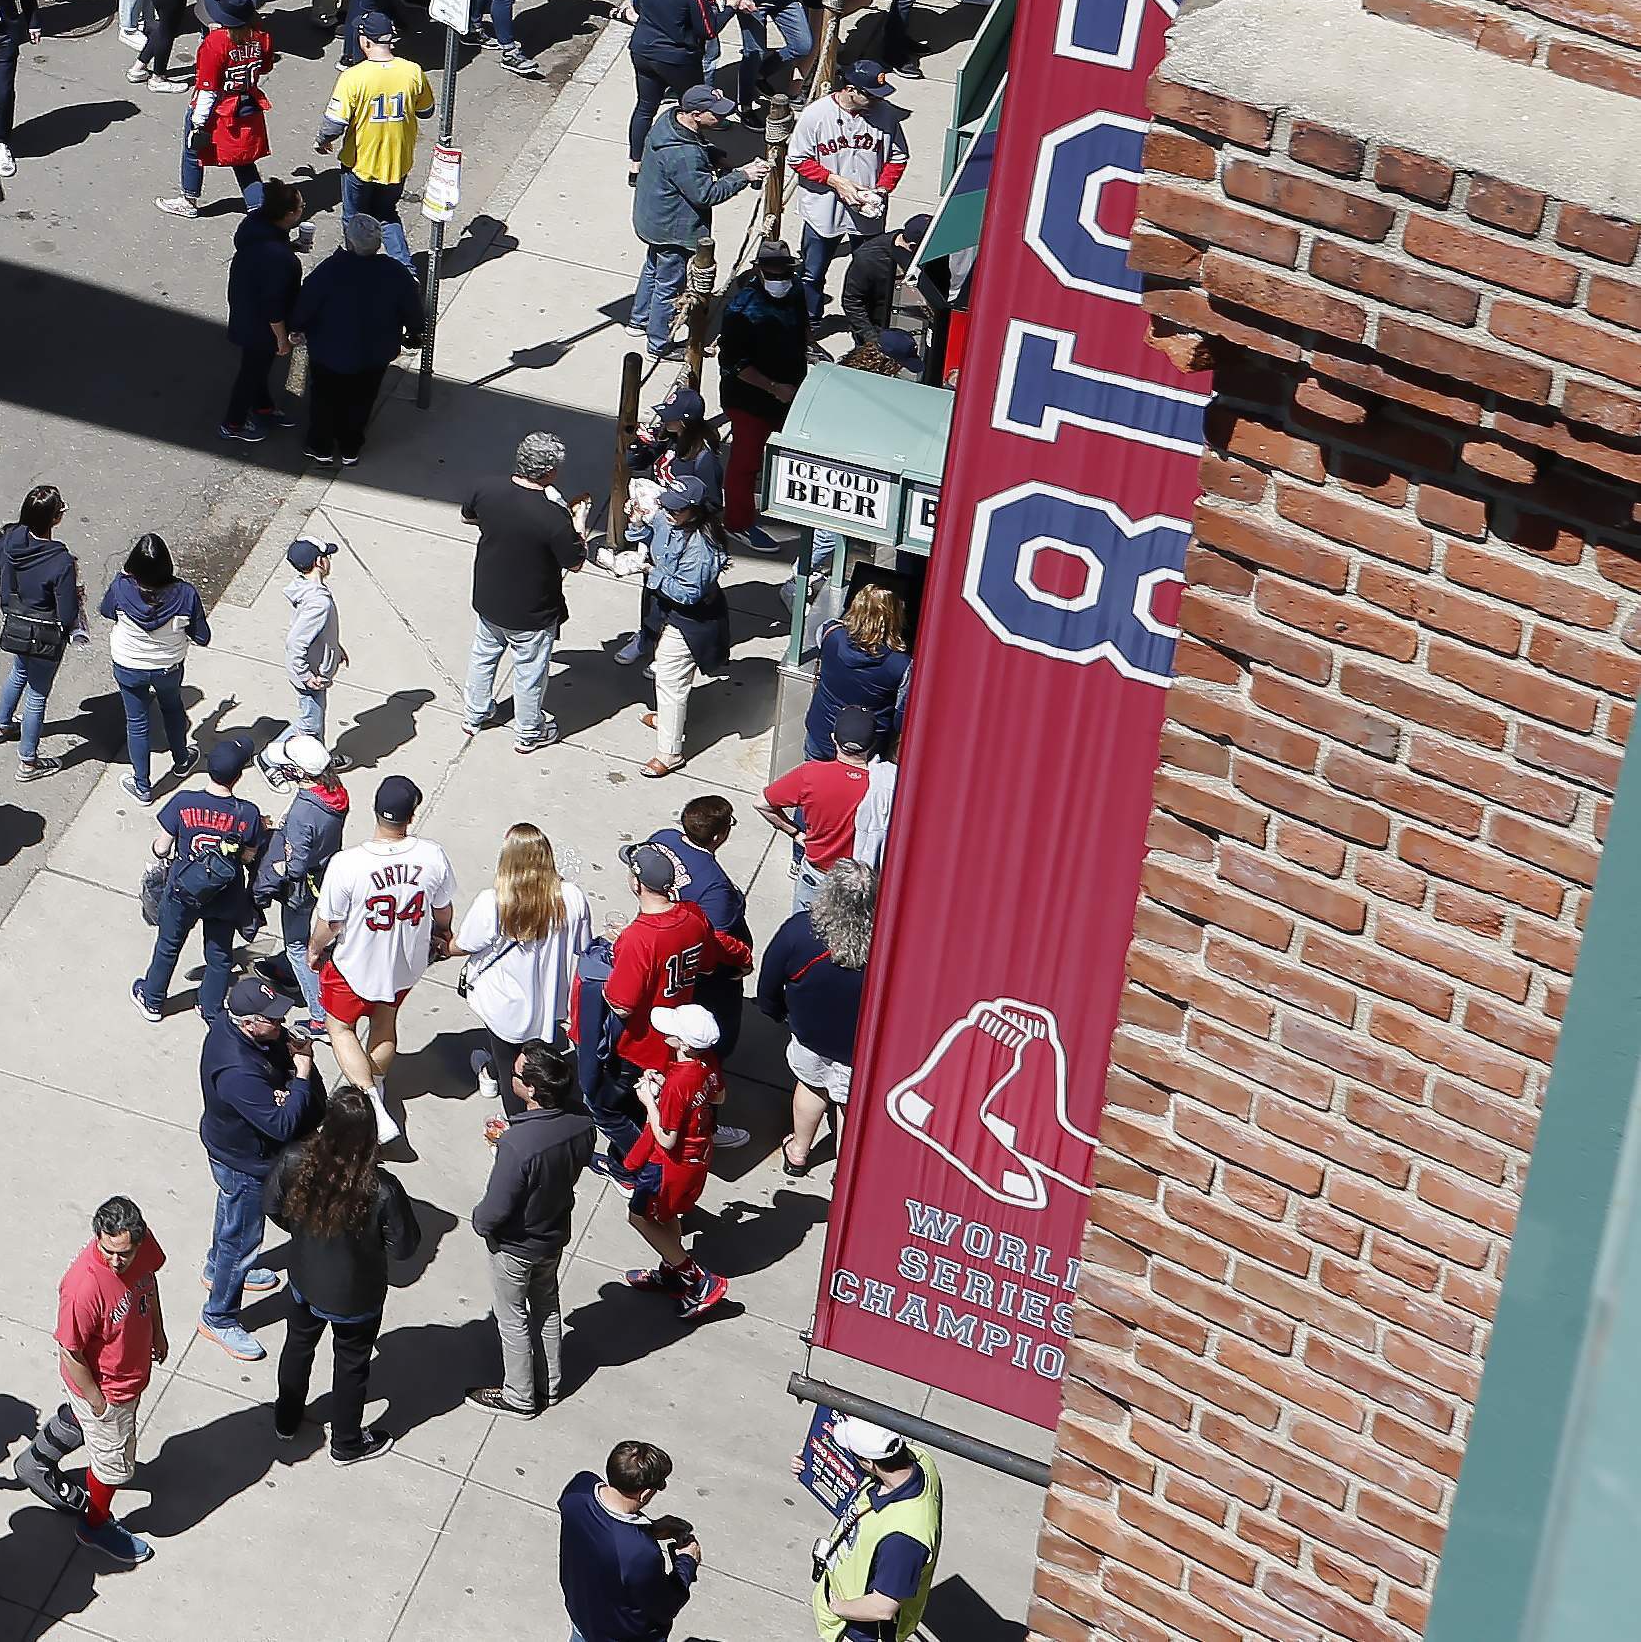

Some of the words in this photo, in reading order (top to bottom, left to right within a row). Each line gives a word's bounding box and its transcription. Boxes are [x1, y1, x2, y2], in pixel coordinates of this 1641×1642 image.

[368, 91, 405, 123] 11
[787, 459, 823, 478] ICE
[825, 468, 880, 495] COLD
[784, 476, 878, 520] BEER
[370, 863, 422, 890] ORTIZ
[365, 891, 425, 932] 34
[898, 1244, 1074, 1338] SERIES
